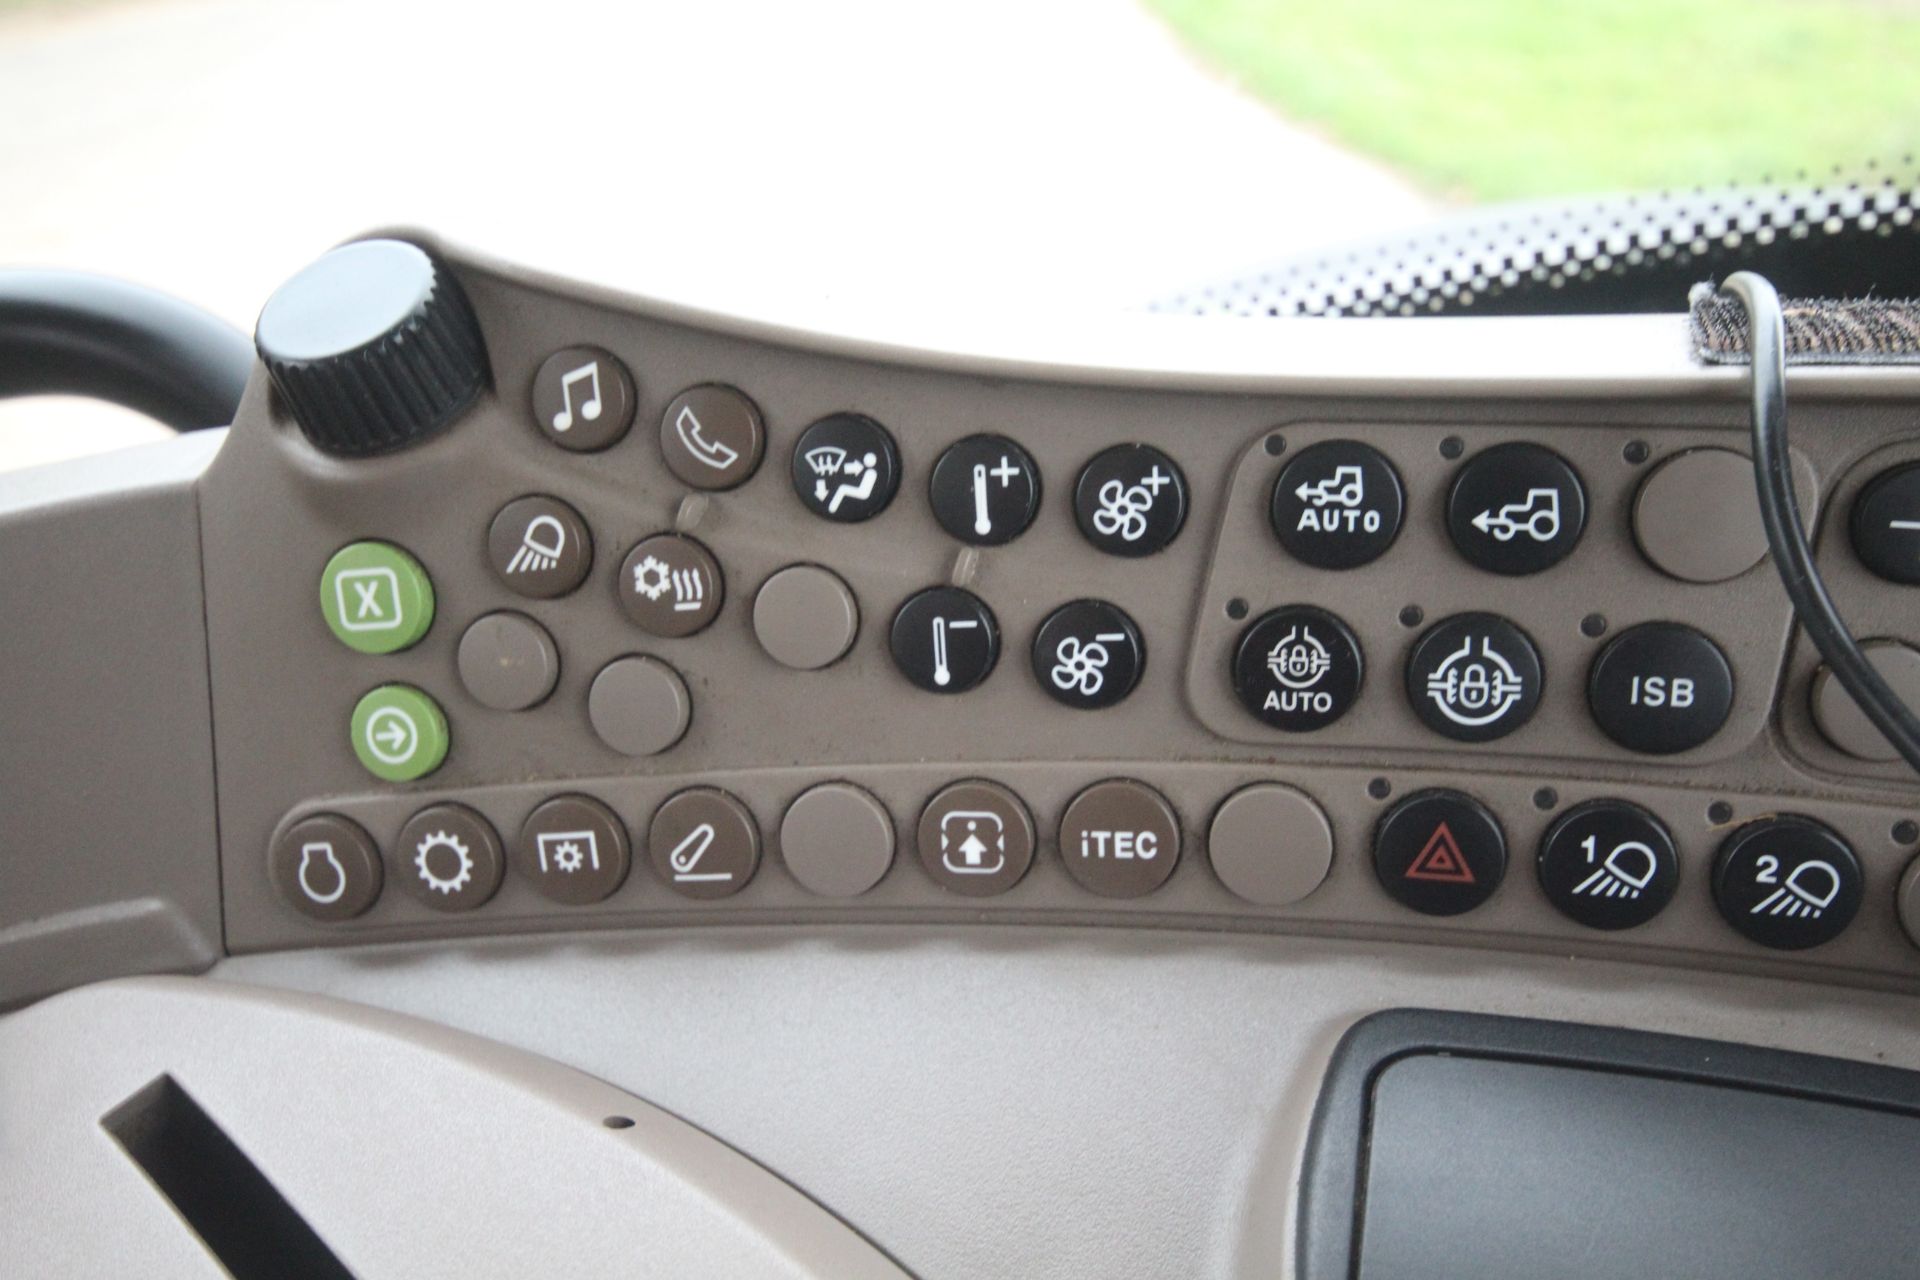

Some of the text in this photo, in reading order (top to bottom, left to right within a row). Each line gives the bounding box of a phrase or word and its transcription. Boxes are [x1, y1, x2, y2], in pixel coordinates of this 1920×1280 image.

[1297, 508, 1380, 533] AUTO
[1263, 690, 1332, 713] AUTO
[1631, 676, 1694, 707] ISB
[1081, 830, 1158, 860] iTEC
[1581, 835, 1595, 863] 1
[1756, 855, 1778, 883] 2
